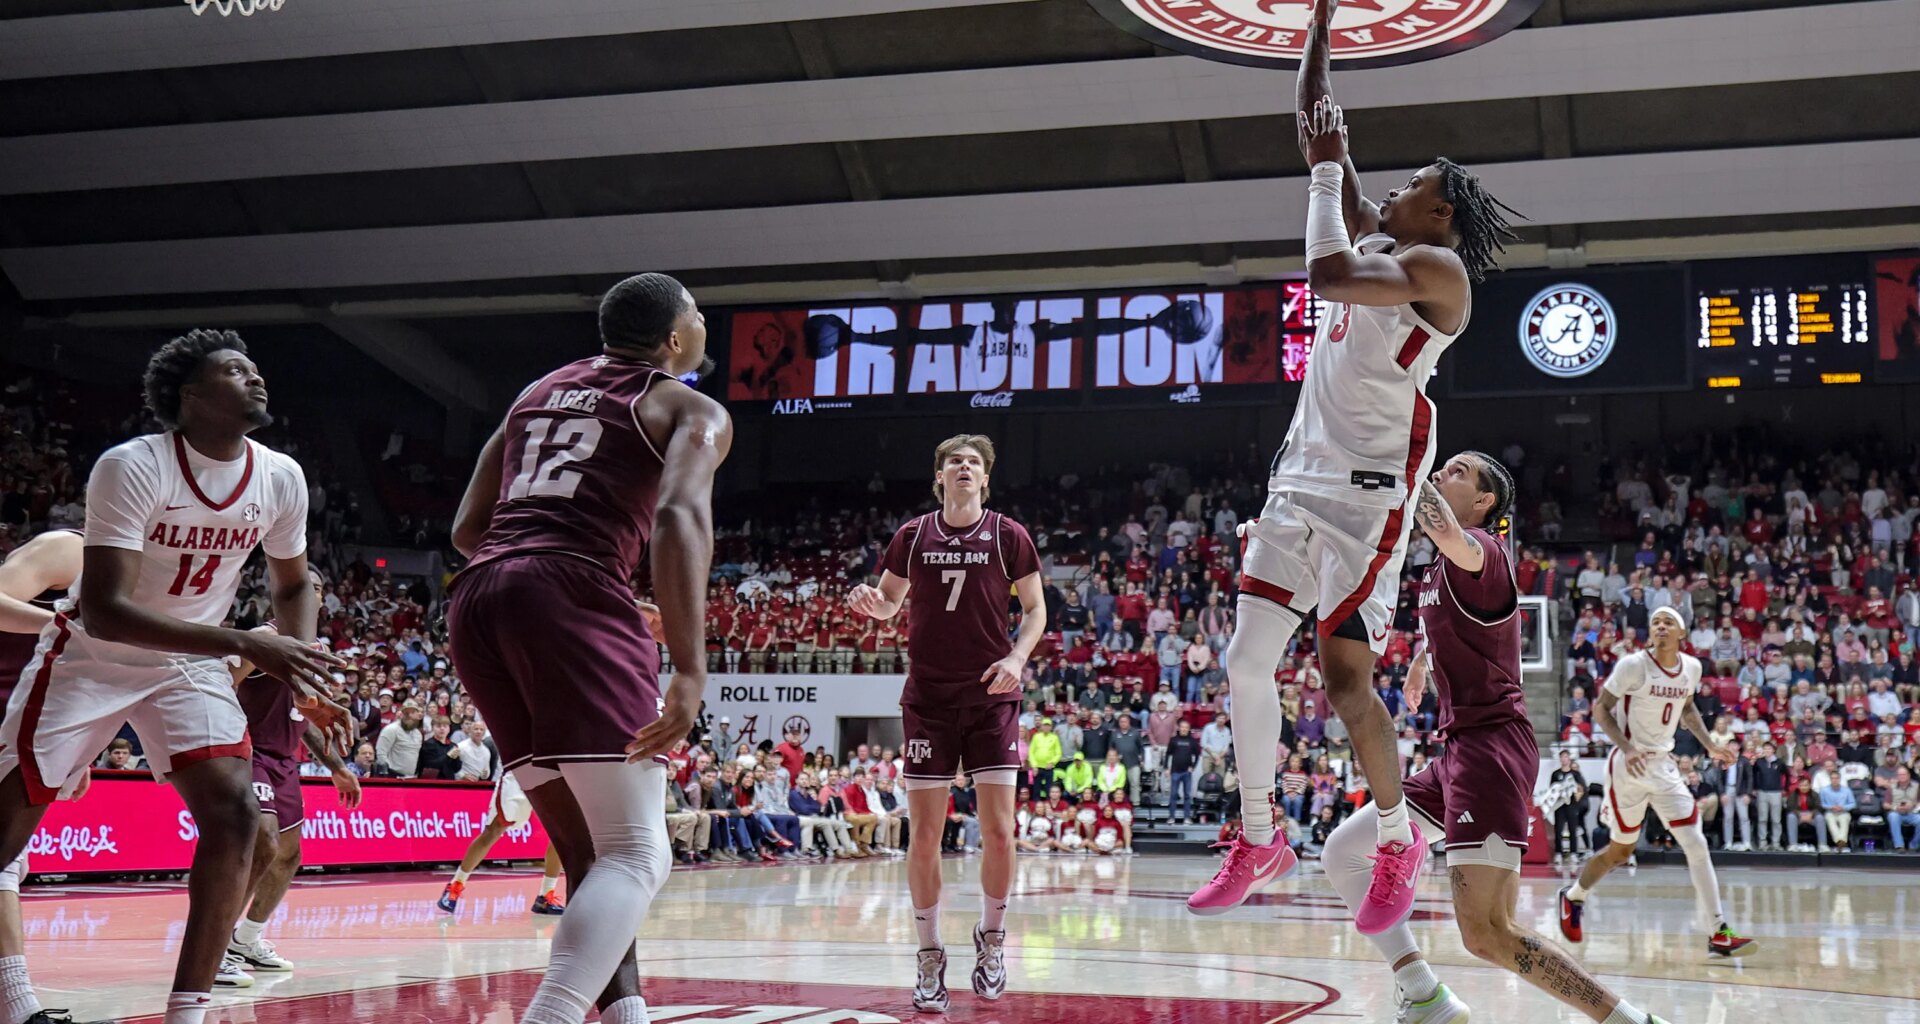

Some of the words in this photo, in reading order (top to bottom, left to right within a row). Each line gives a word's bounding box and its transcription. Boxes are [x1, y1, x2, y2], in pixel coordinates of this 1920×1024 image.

[1188, 9, 1296, 46] TIDE
[1530, 291, 1605, 326] ALABAMA
[808, 292, 1225, 397] TRADITION
[548, 389, 604, 414] AGEE
[771, 398, 814, 415] ALFA
[508, 417, 604, 501] 12
[149, 522, 260, 550] ALABAMA
[168, 553, 222, 596] 14
[922, 552, 961, 565] TEXAS
[964, 552, 989, 565] A&M
[941, 570, 967, 612] 7
[720, 686, 770, 702] ROLL
[775, 686, 817, 702] TIDE
[1661, 703, 1673, 725] 0
[301, 810, 347, 839] with
[350, 810, 386, 839] the
[28, 825, 118, 861] ck-fil-A
